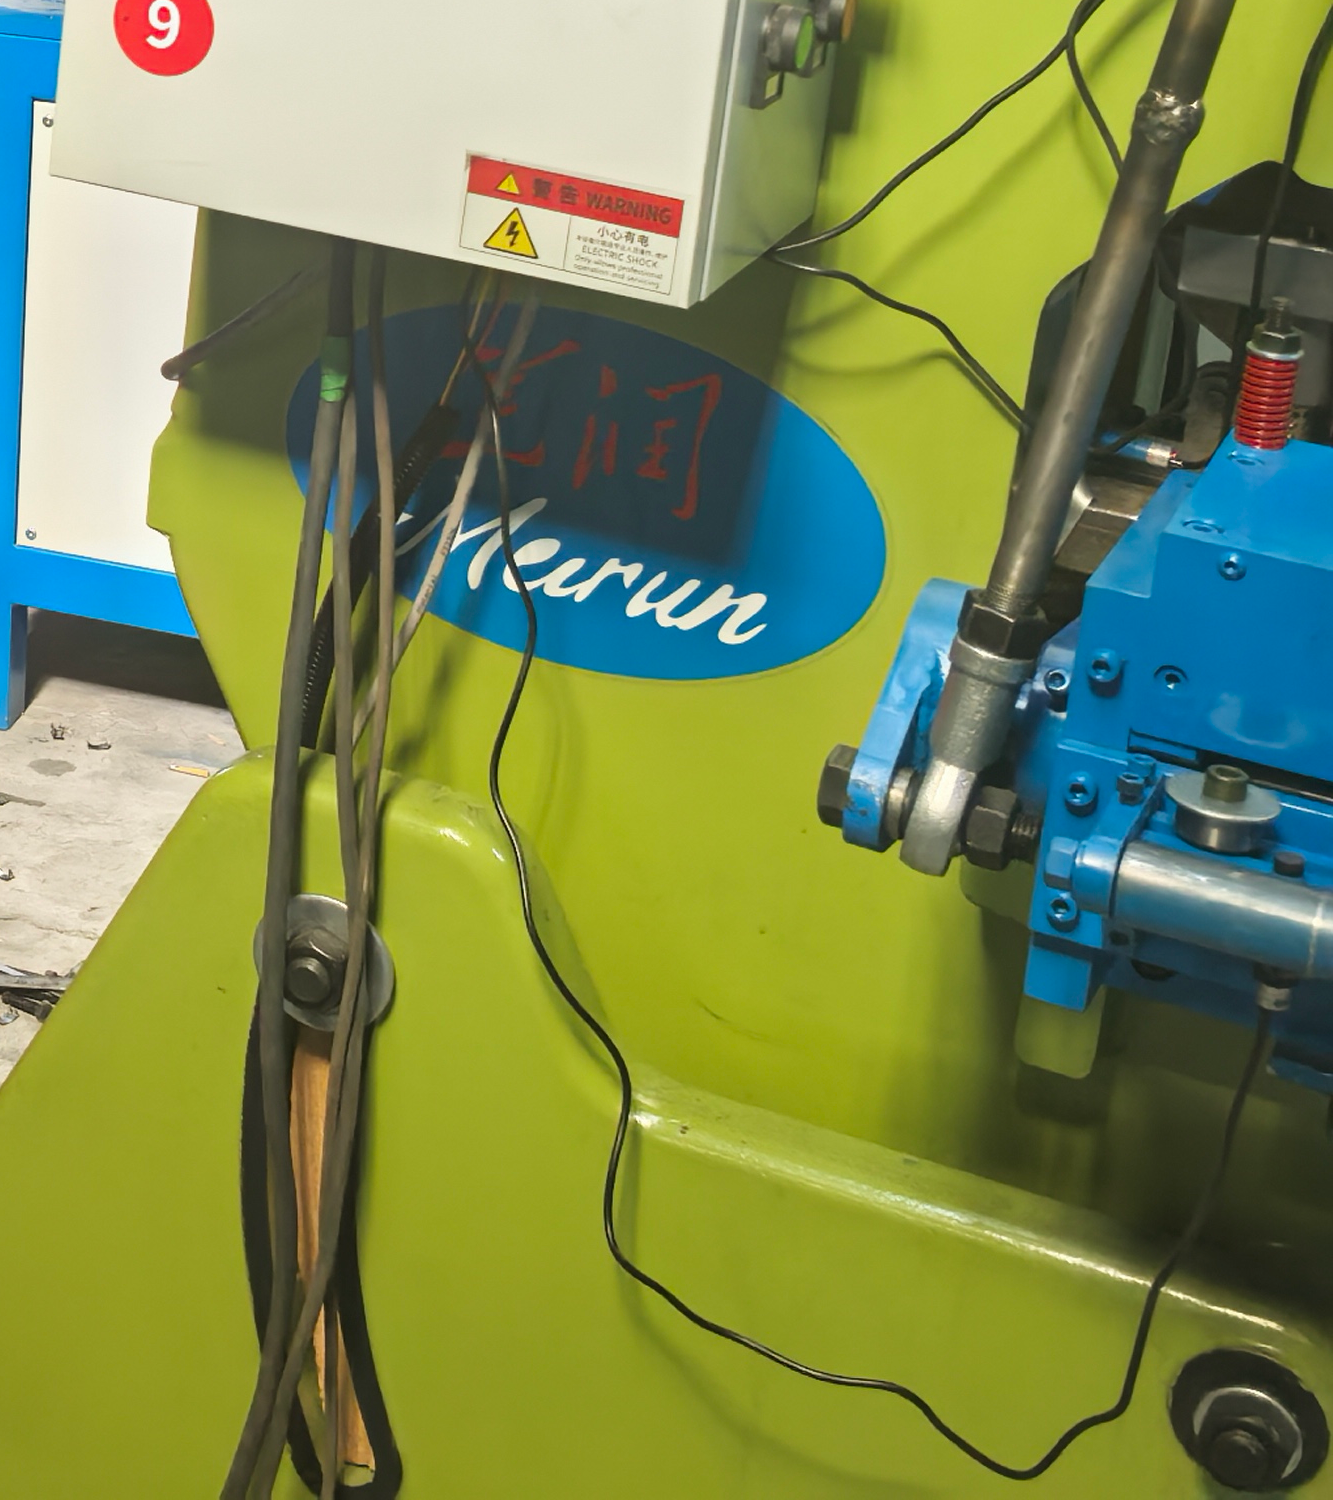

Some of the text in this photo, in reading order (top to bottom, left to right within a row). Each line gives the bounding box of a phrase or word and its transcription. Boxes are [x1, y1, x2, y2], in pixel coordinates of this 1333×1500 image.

[586, 190, 672, 225] WARNING
[597, 225, 649, 248] 小心有电
[582, 245, 659, 269] ELECTRIC SHOCK
